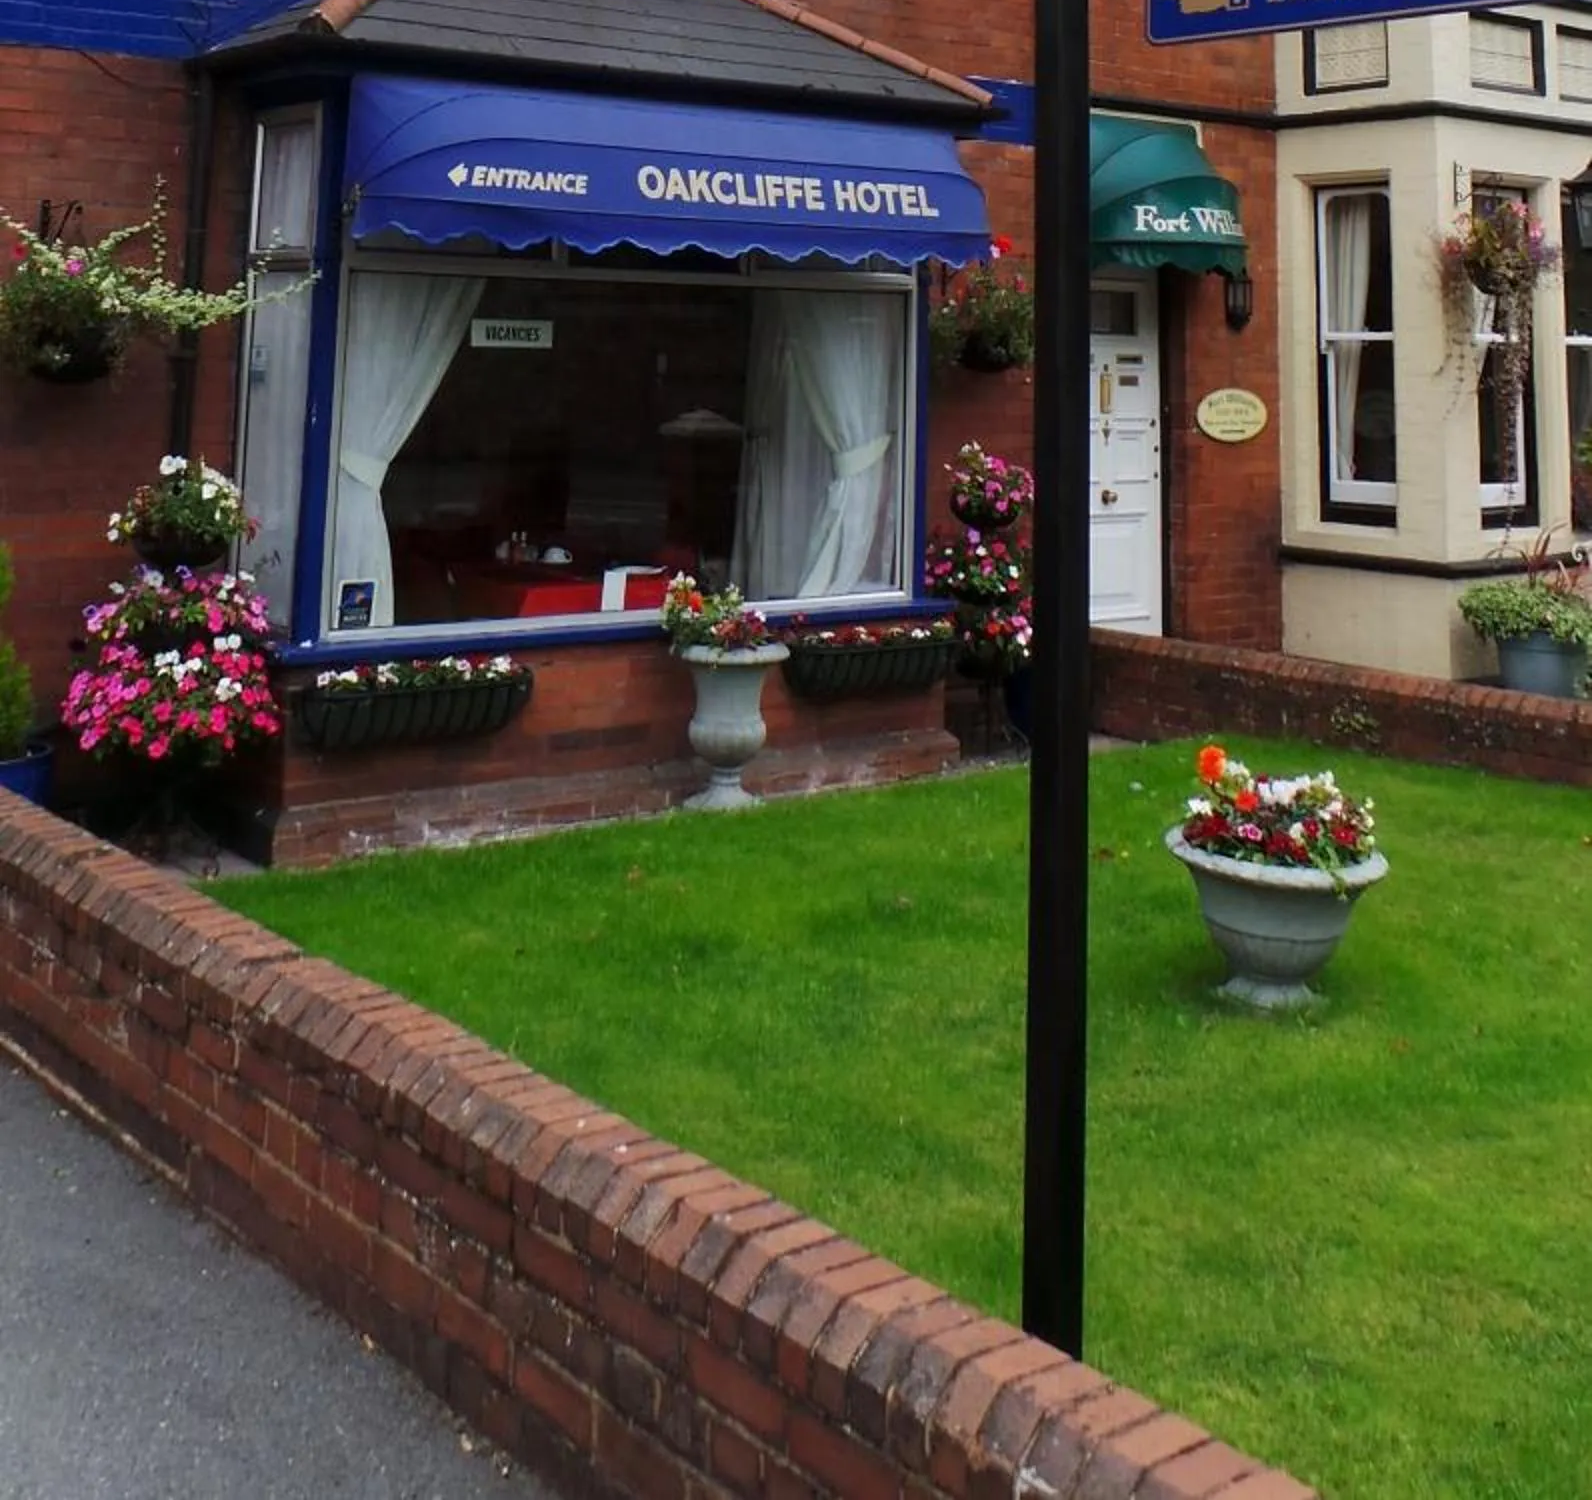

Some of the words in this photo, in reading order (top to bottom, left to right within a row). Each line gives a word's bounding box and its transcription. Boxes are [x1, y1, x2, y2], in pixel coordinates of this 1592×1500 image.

[470, 165, 590, 196] ENTRANCE
[637, 165, 826, 212] OAKCLIFFE
[832, 179, 940, 218] HOTEL
[1134, 205, 1190, 232] Fort
